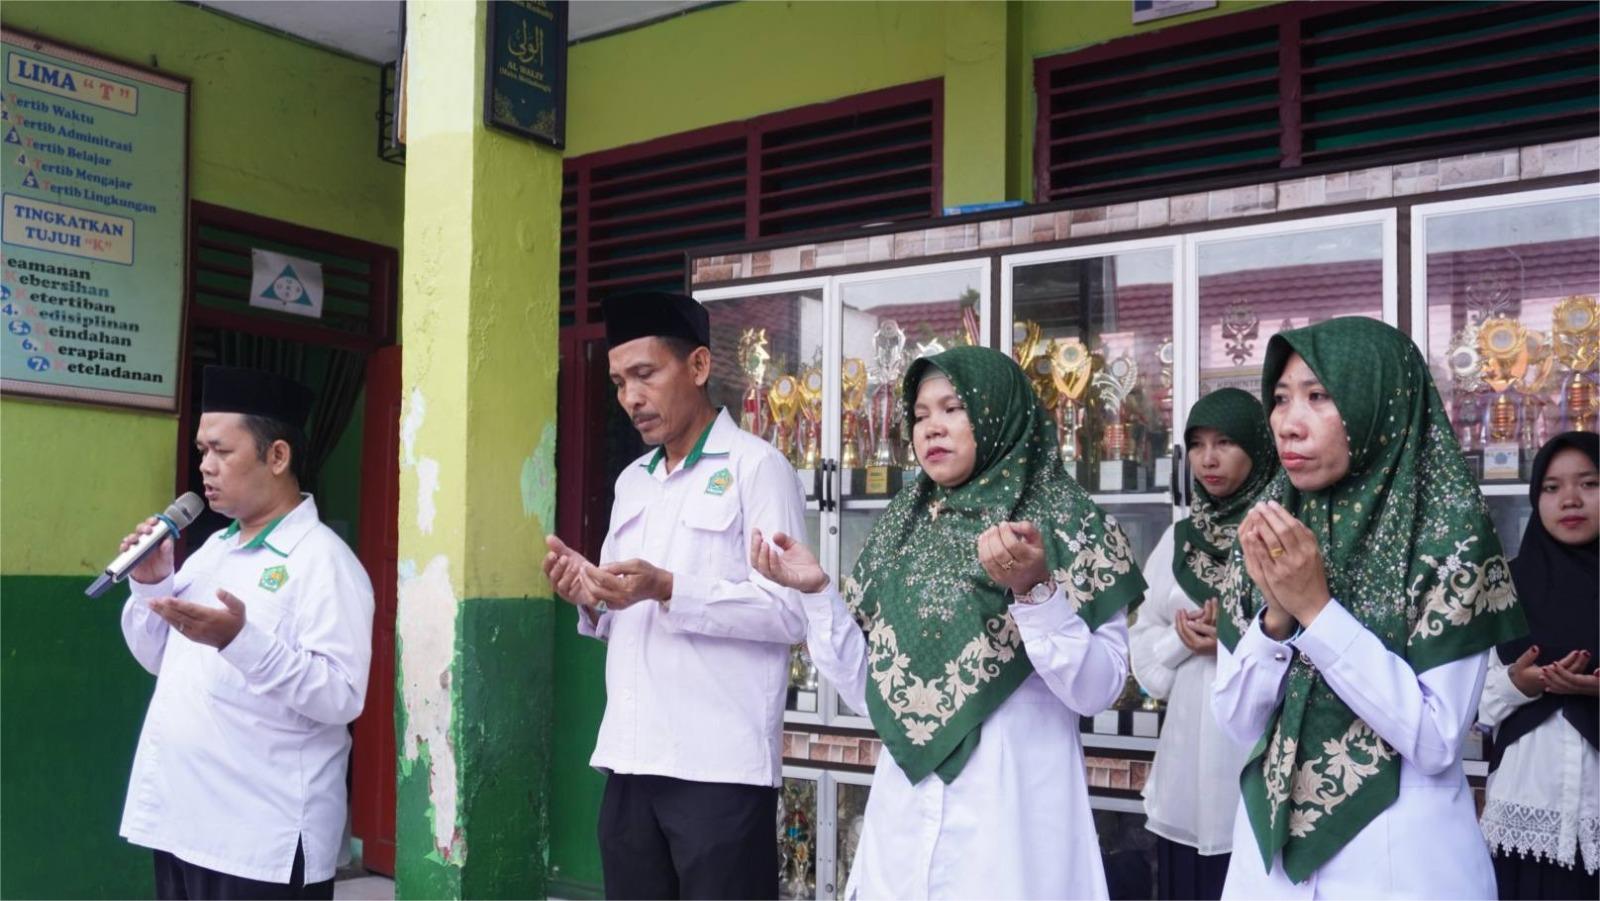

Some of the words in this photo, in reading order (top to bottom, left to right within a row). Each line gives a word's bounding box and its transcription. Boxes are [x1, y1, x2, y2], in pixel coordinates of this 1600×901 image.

[17, 59, 77, 92] LIMA
[9, 92, 49, 112] Tertib
[52, 104, 94, 125] Waktu
[15, 114, 56, 134] Tertib
[58, 126, 133, 153] Adminitrasi
[26, 136, 65, 156] Tertib
[67, 147, 112, 166] Belajar
[34, 159, 73, 177] Tertib
[76, 170, 133, 192] Mengajar
[43, 180, 82, 198] Tertib
[84, 189, 157, 214] Lingkungan
[14, 204, 124, 237] TINGKATKAN
[25, 226, 81, 248] TUJUH
[5, 270, 110, 298] Kebersihan
[15, 288, 116, 314] Ketertiban
[26, 304, 140, 332] Kedisiplinan
[35, 322, 132, 347] Keindahan
[45, 341, 127, 363] Kerapian
[53, 359, 164, 383] Keteladanan
